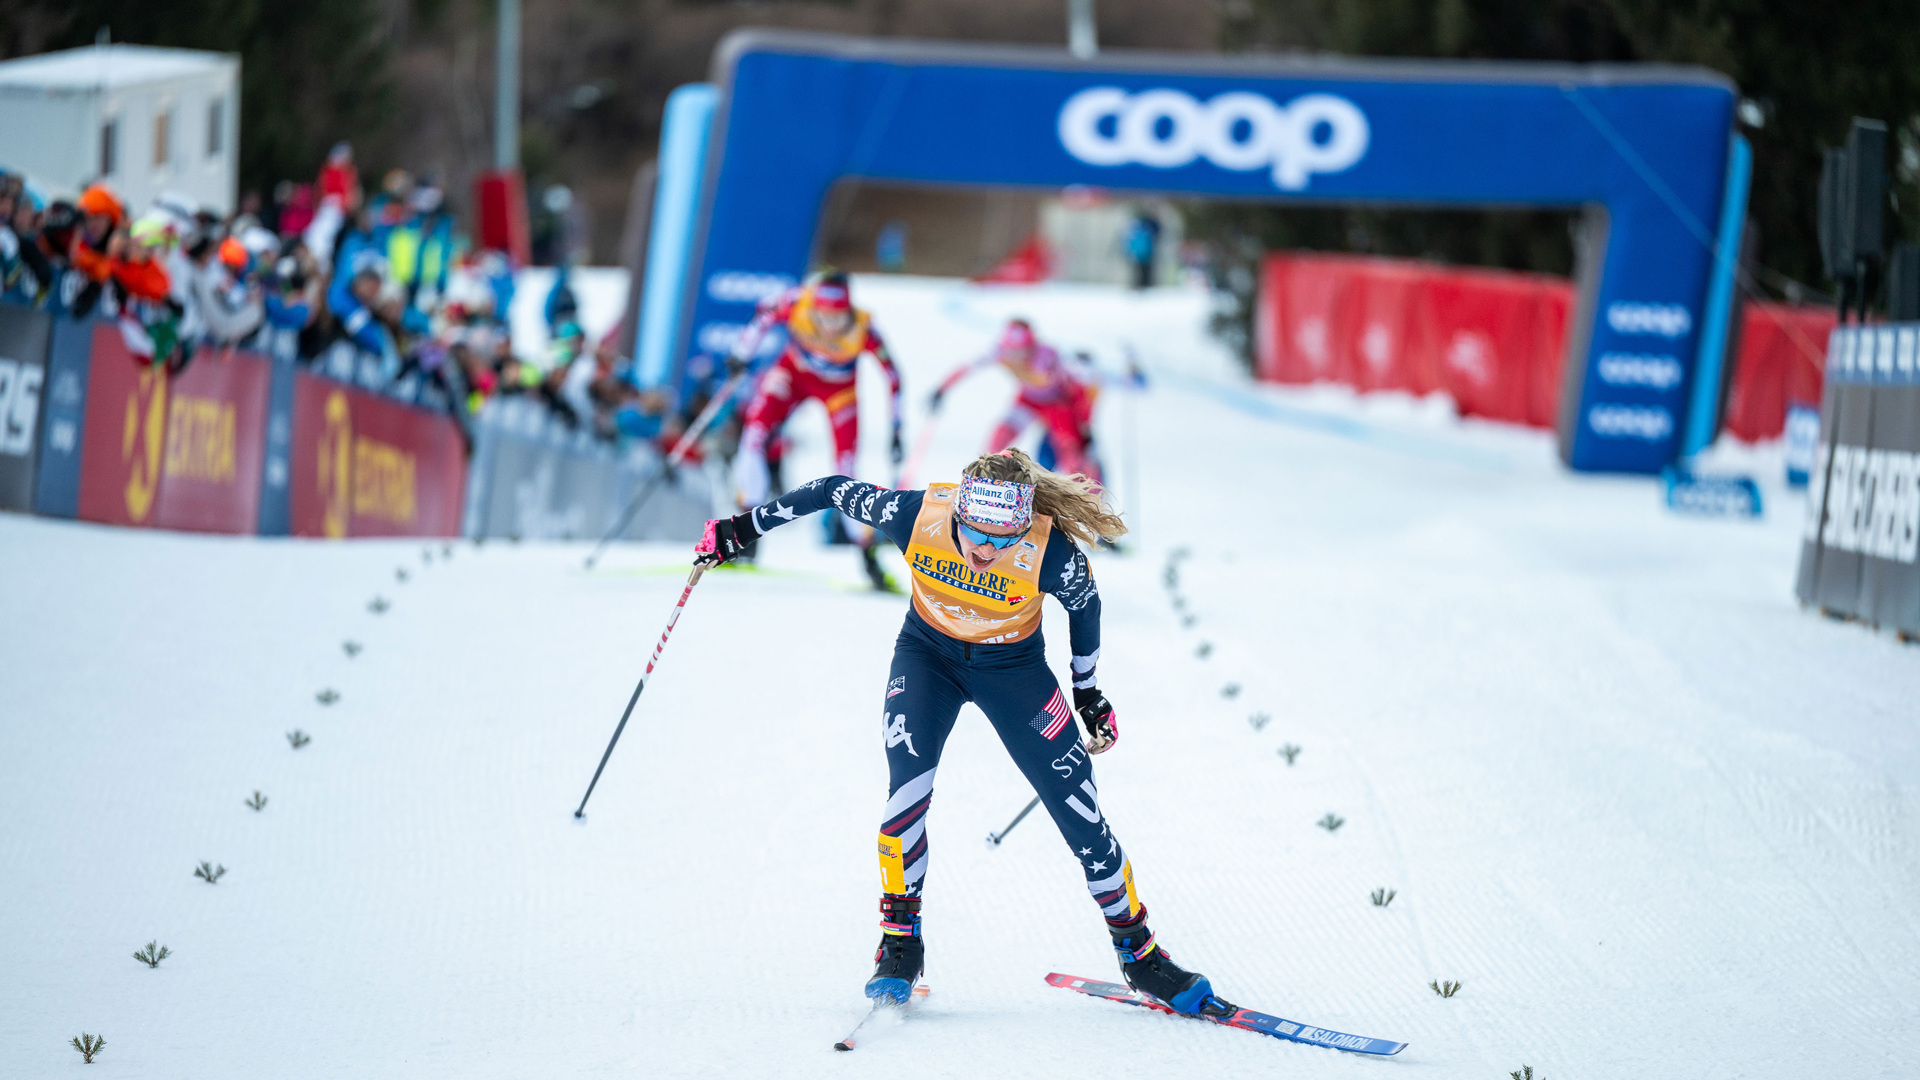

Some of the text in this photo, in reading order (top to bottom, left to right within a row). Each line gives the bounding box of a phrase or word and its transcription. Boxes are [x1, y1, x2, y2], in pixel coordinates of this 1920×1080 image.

[1057, 87, 1368, 190] coop
[971, 485, 1003, 499] Allianz
[913, 552, 933, 568] LE
[915, 565, 1001, 599] SWITZERLAND
[1311, 1028, 1374, 1050] SALOMON
